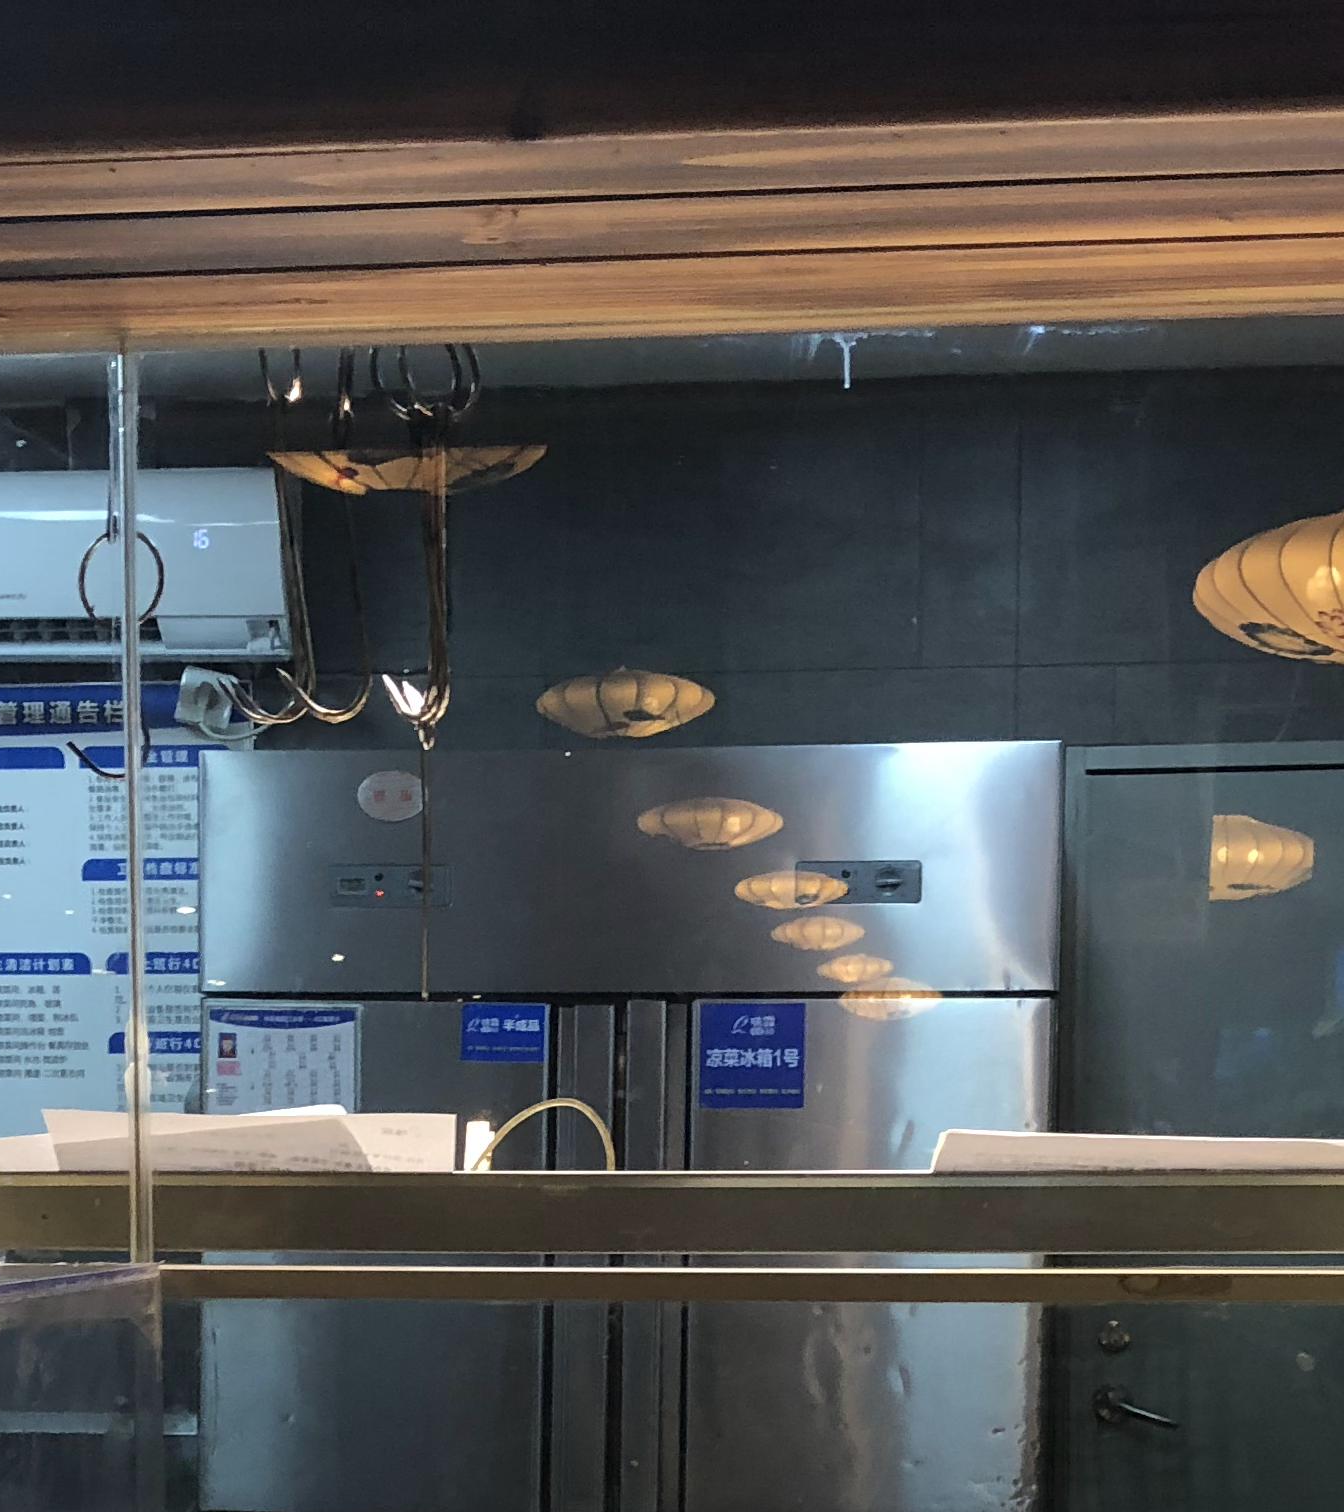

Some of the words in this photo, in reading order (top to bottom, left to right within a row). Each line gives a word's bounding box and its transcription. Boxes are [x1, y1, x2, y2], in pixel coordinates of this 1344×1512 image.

[705, 1047, 801, 1069] 凉菜冰箱1号
